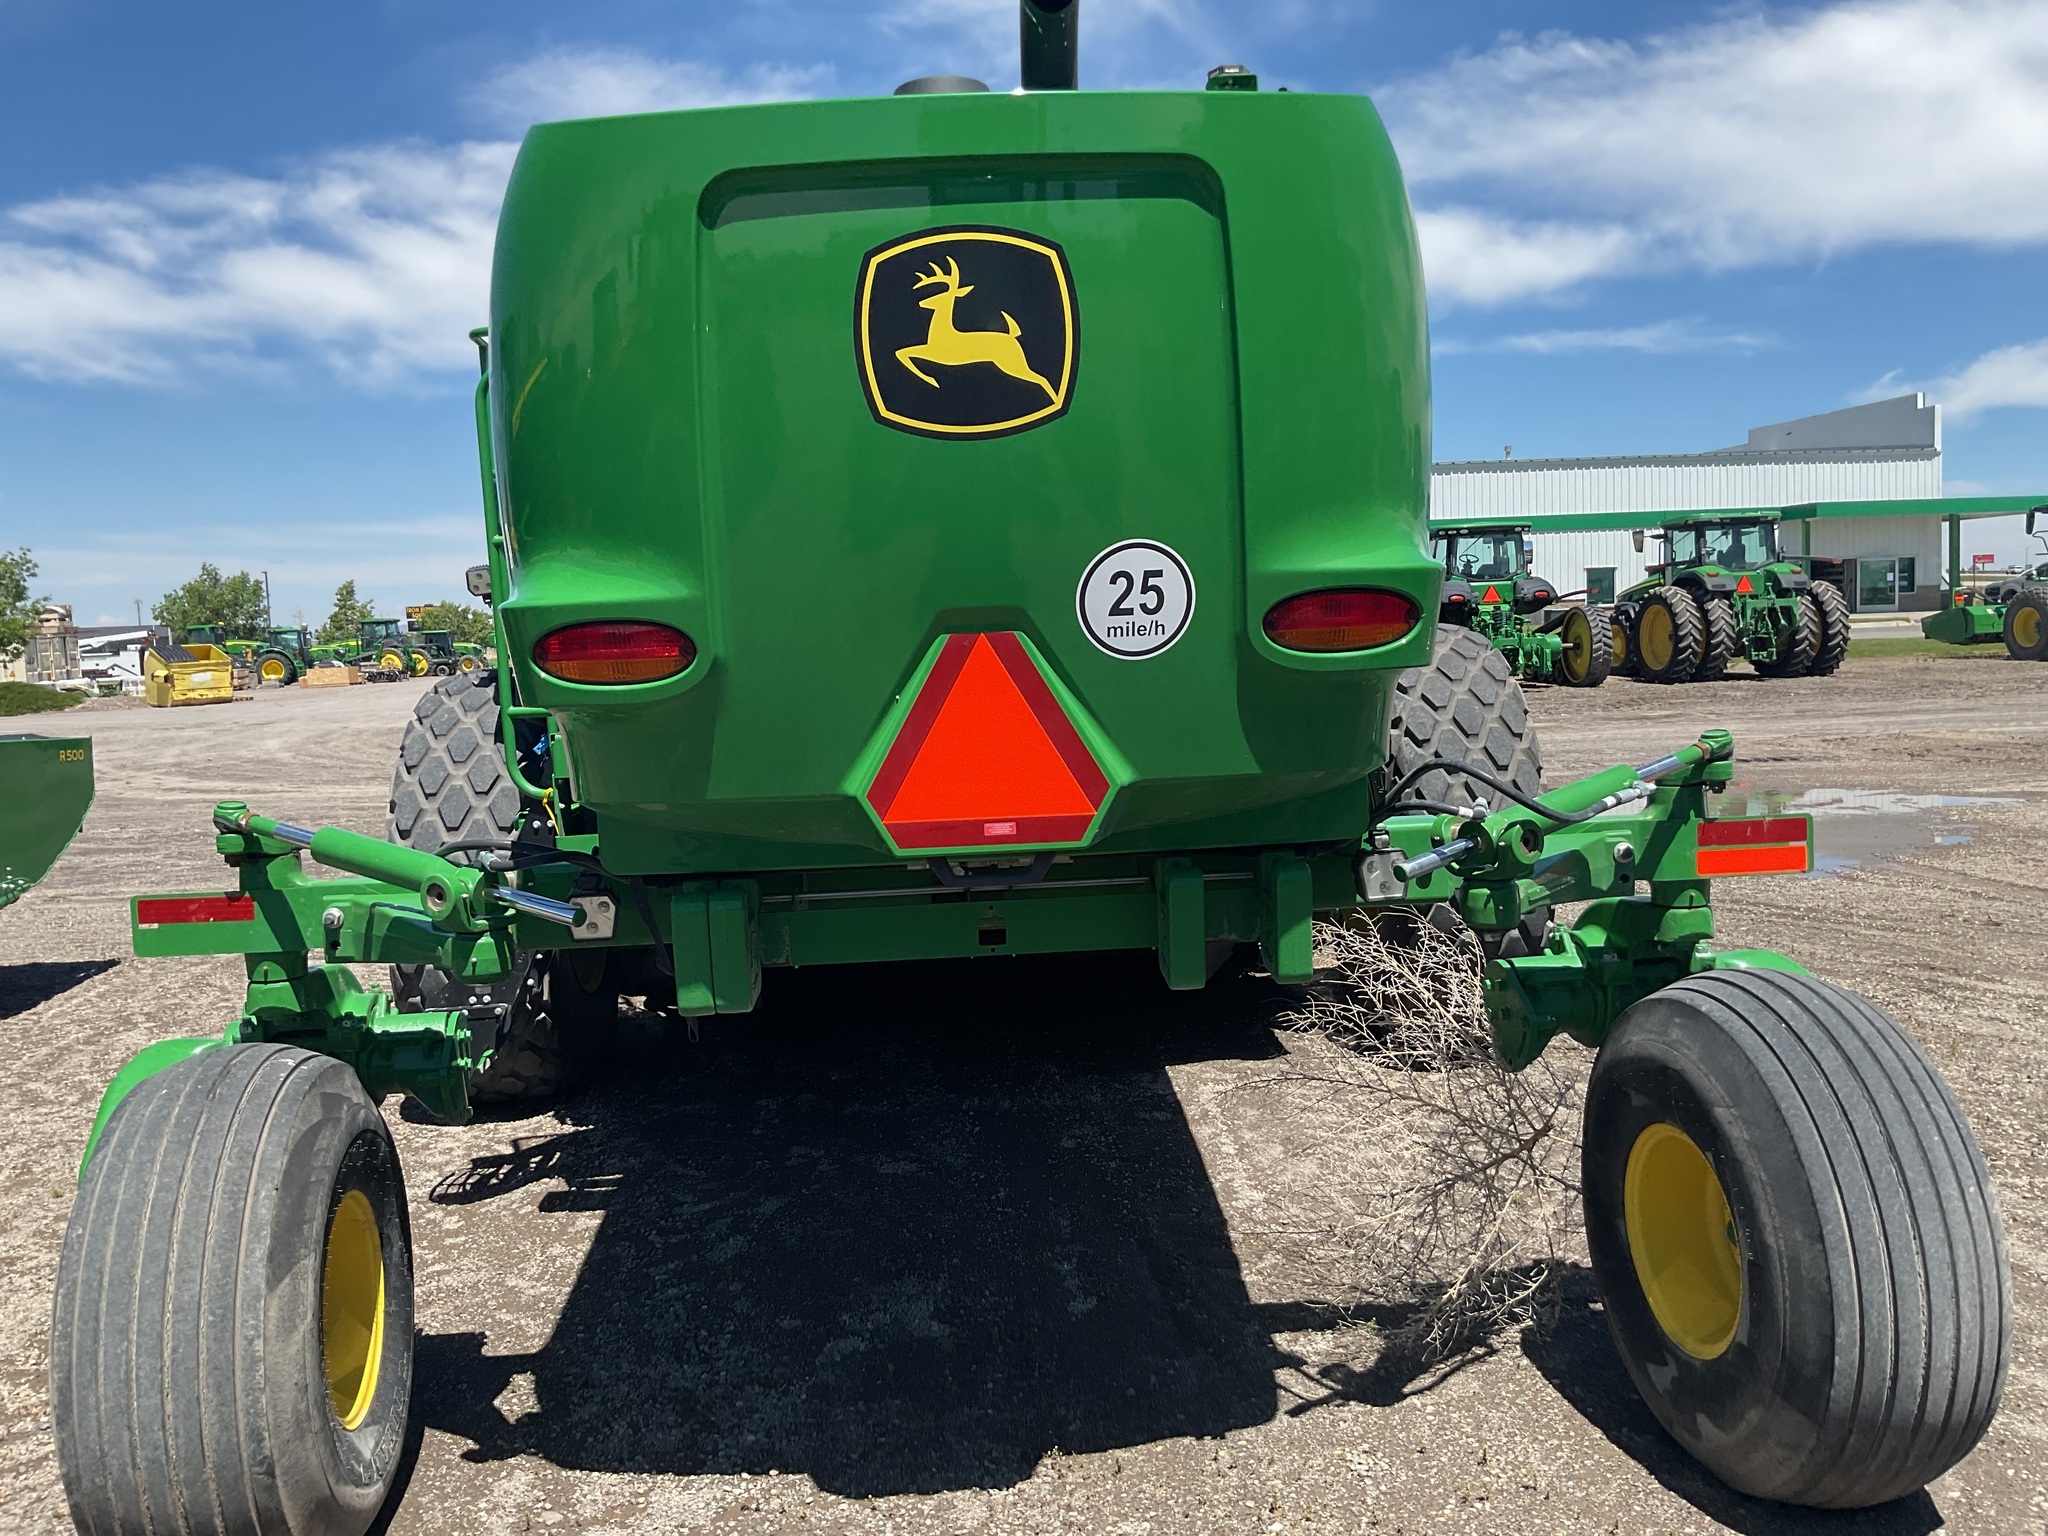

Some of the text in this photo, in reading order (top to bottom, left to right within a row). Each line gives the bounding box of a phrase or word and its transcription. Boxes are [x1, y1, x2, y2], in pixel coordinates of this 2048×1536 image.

[1108, 569, 1165, 617] 25
[1107, 620, 1165, 638] mile/h
[59, 748, 84, 761] R500
